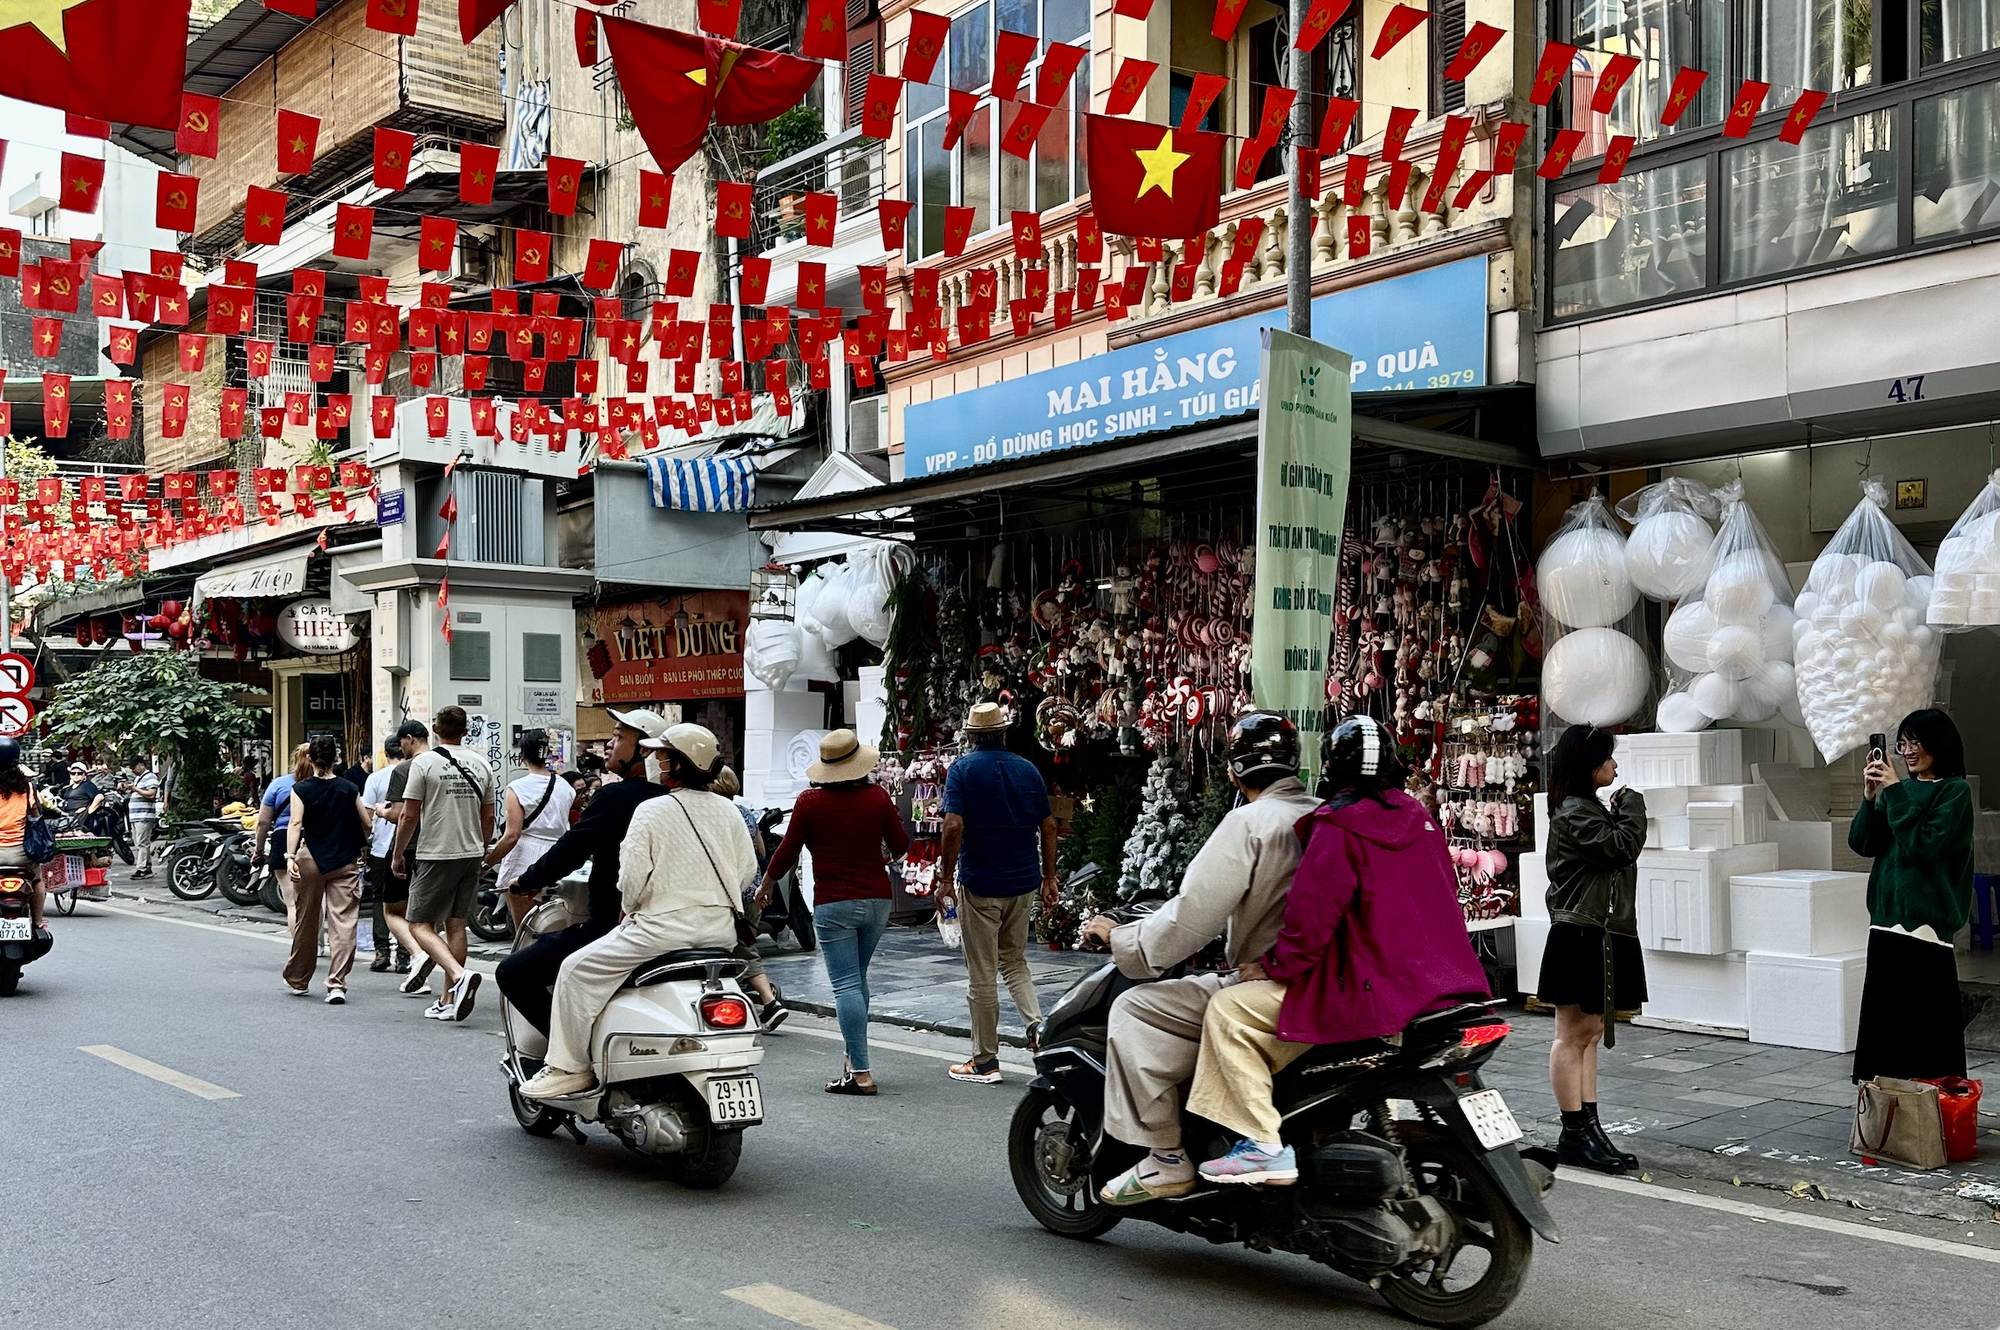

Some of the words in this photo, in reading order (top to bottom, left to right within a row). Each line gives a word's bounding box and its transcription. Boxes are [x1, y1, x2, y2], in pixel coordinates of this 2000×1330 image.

[1427, 368, 1475, 390] 3979
[1887, 375, 1925, 403] 47
[925, 451, 957, 473] VPP
[973, 435, 997, 463] ĐỒ
[1002, 431, 1053, 457] DÙNG
[1058, 418, 1099, 446] HỌC
[1105, 405, 1157, 434] SINH
[1179, 390, 1216, 419] TÚI
[1349, 360, 1368, 385] P
[1377, 340, 1440, 379] QUÀ
[1046, 375, 1112, 418] MAI
[1291, 526, 1303, 549] AN
[301, 603, 318, 615] CÀ
[293, 617, 350, 641] HIỆP
[613, 618, 668, 668] VIỆT
[675, 612, 738, 658] DŨNG
[715, 1080, 753, 1100] 29-Y1
[718, 1099, 757, 1120] 0593
